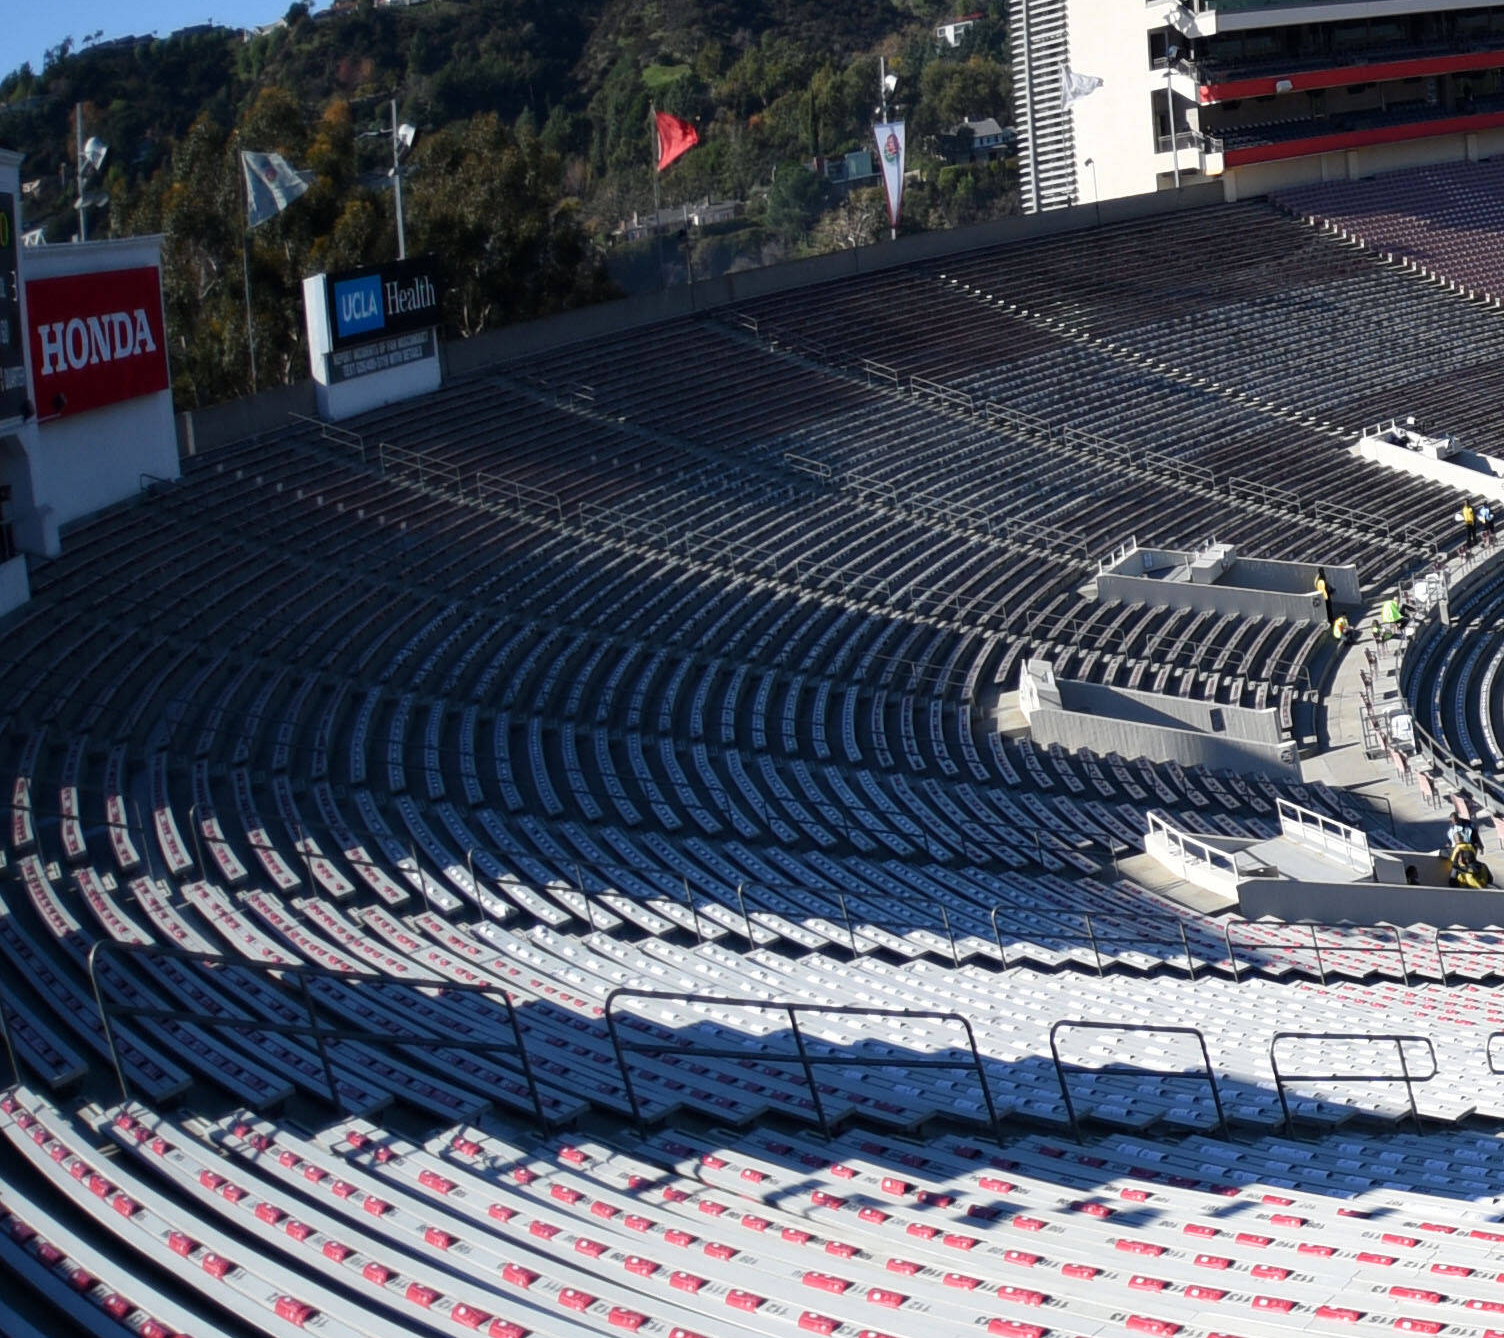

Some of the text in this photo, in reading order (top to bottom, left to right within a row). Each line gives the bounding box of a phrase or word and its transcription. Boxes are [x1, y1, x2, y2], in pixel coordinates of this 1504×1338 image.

[341, 275, 436, 323] UCLA Health
[38, 308, 157, 376] HONDA
